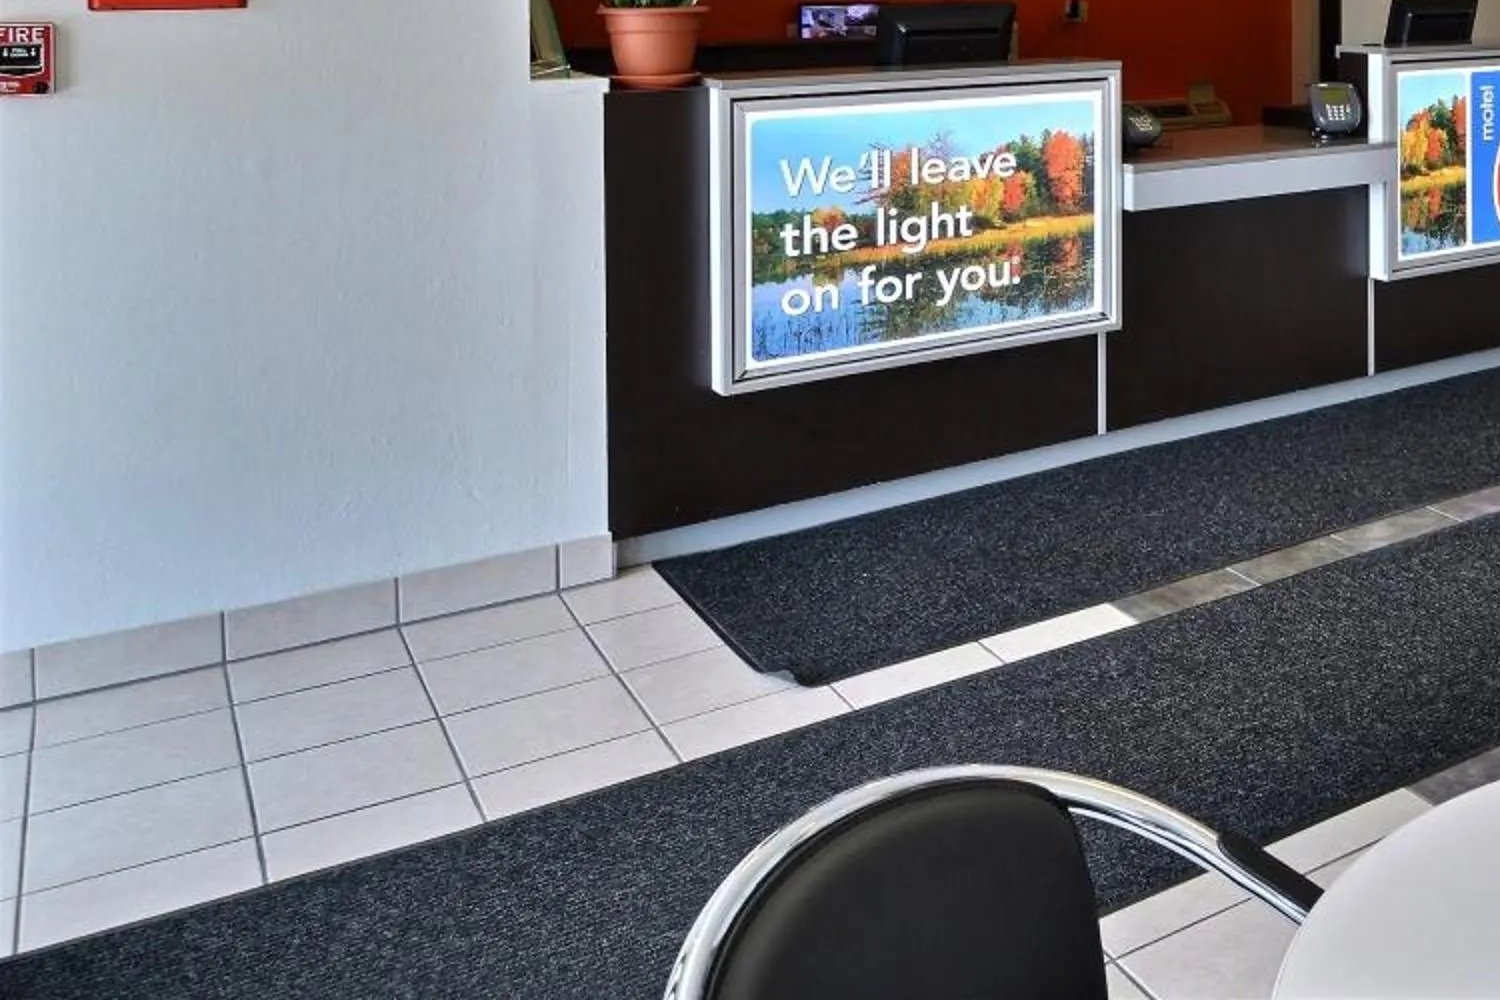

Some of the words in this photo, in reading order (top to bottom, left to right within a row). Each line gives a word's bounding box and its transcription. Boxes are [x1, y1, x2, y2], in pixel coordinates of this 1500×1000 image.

[1480, 85, 1495, 142] motel
[780, 150, 892, 198] We'll
[911, 147, 1017, 185] leave
[780, 214, 858, 257] the
[876, 201, 973, 254] light
[781, 282, 839, 316] on
[857, 264, 922, 306] for
